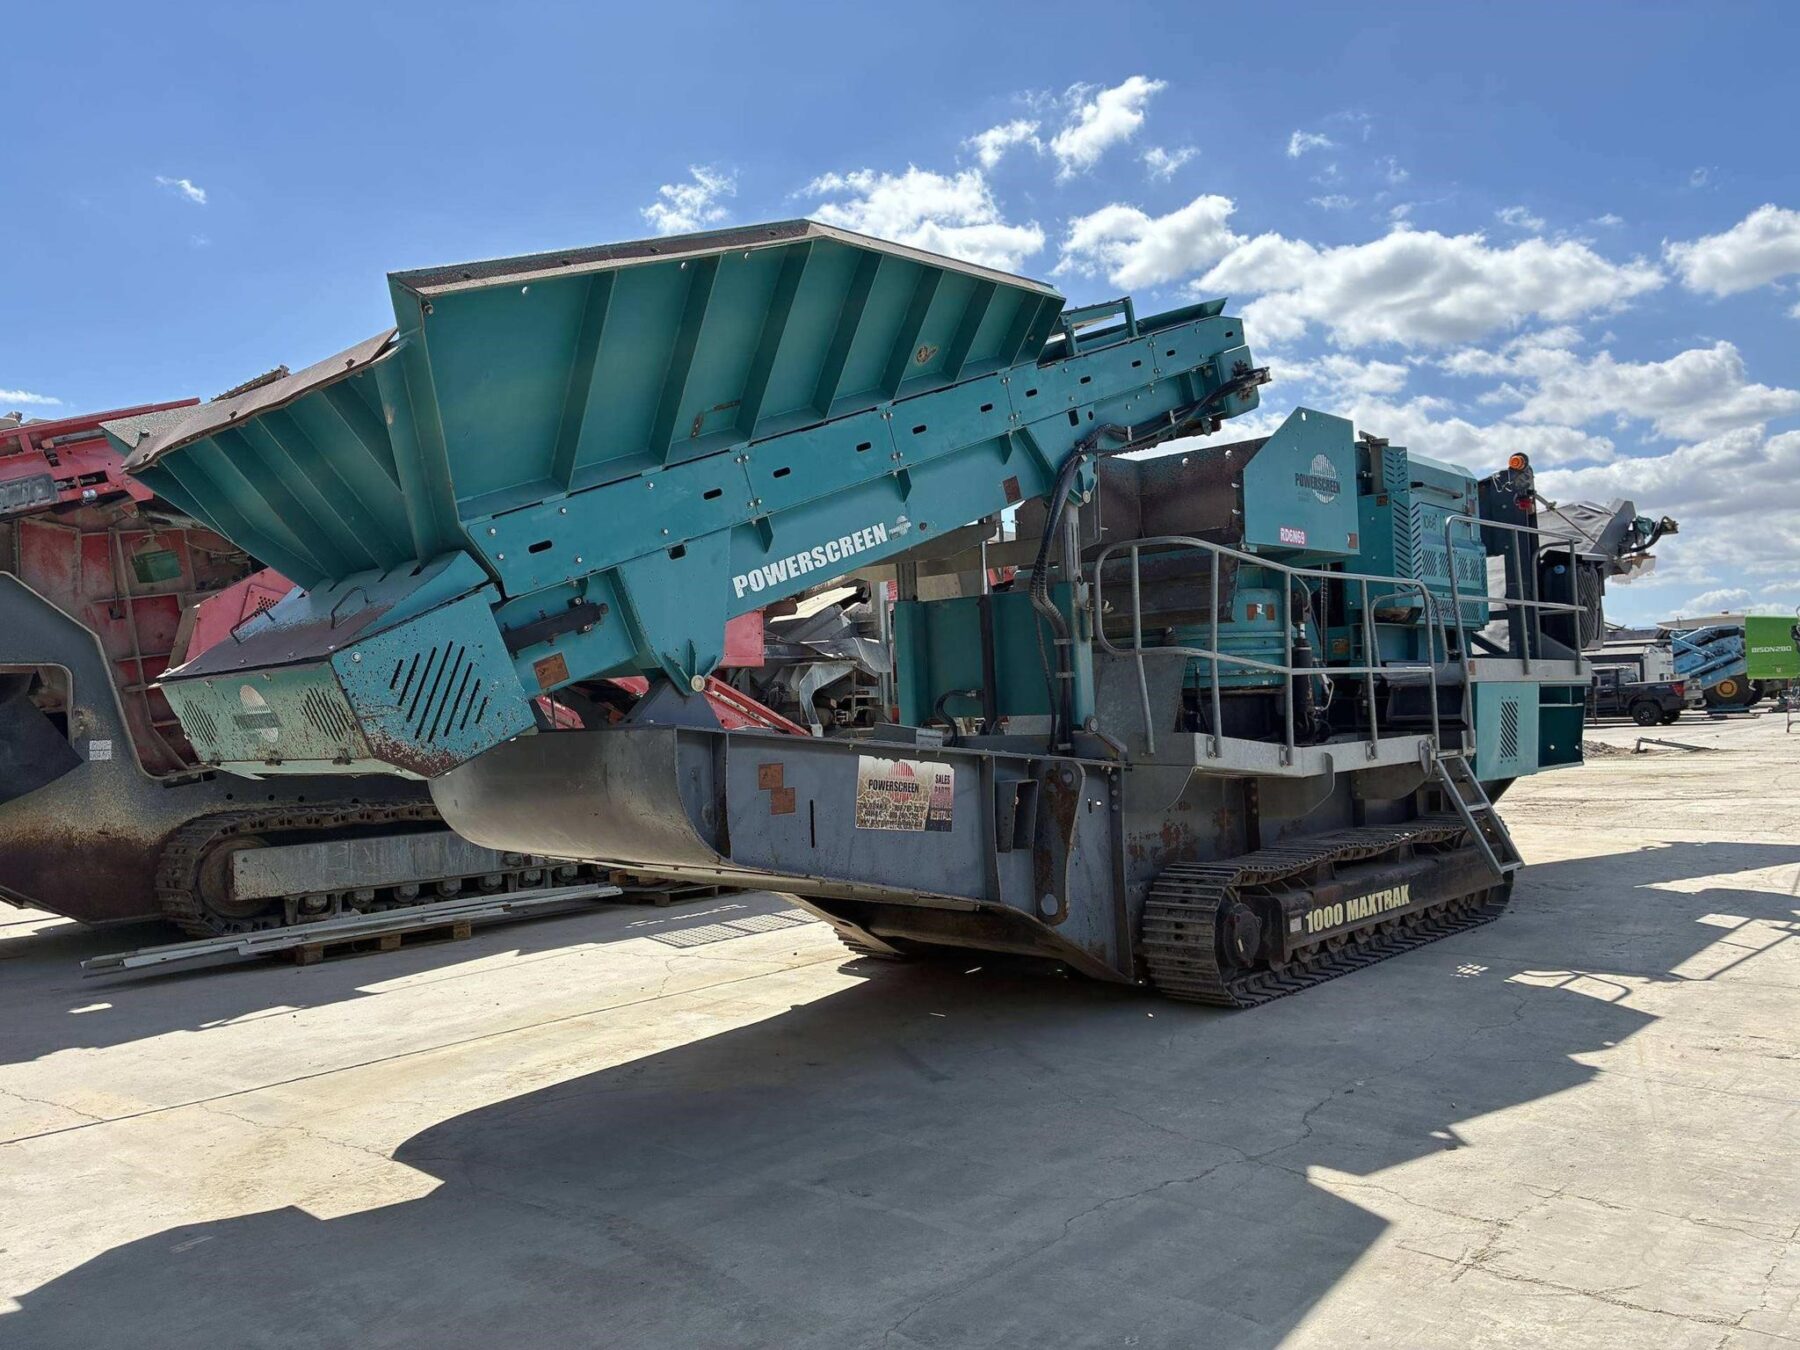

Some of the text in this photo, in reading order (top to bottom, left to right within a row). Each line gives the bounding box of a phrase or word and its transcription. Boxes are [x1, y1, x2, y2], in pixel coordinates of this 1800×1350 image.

[1294, 472, 1341, 494] POWERSCREEN
[732, 522, 888, 599] POWERSCREEN
[868, 779, 920, 793] POWERSCREEN
[935, 773, 951, 785] SALES
[1305, 884, 1410, 933] 1000 MAXTRAK
